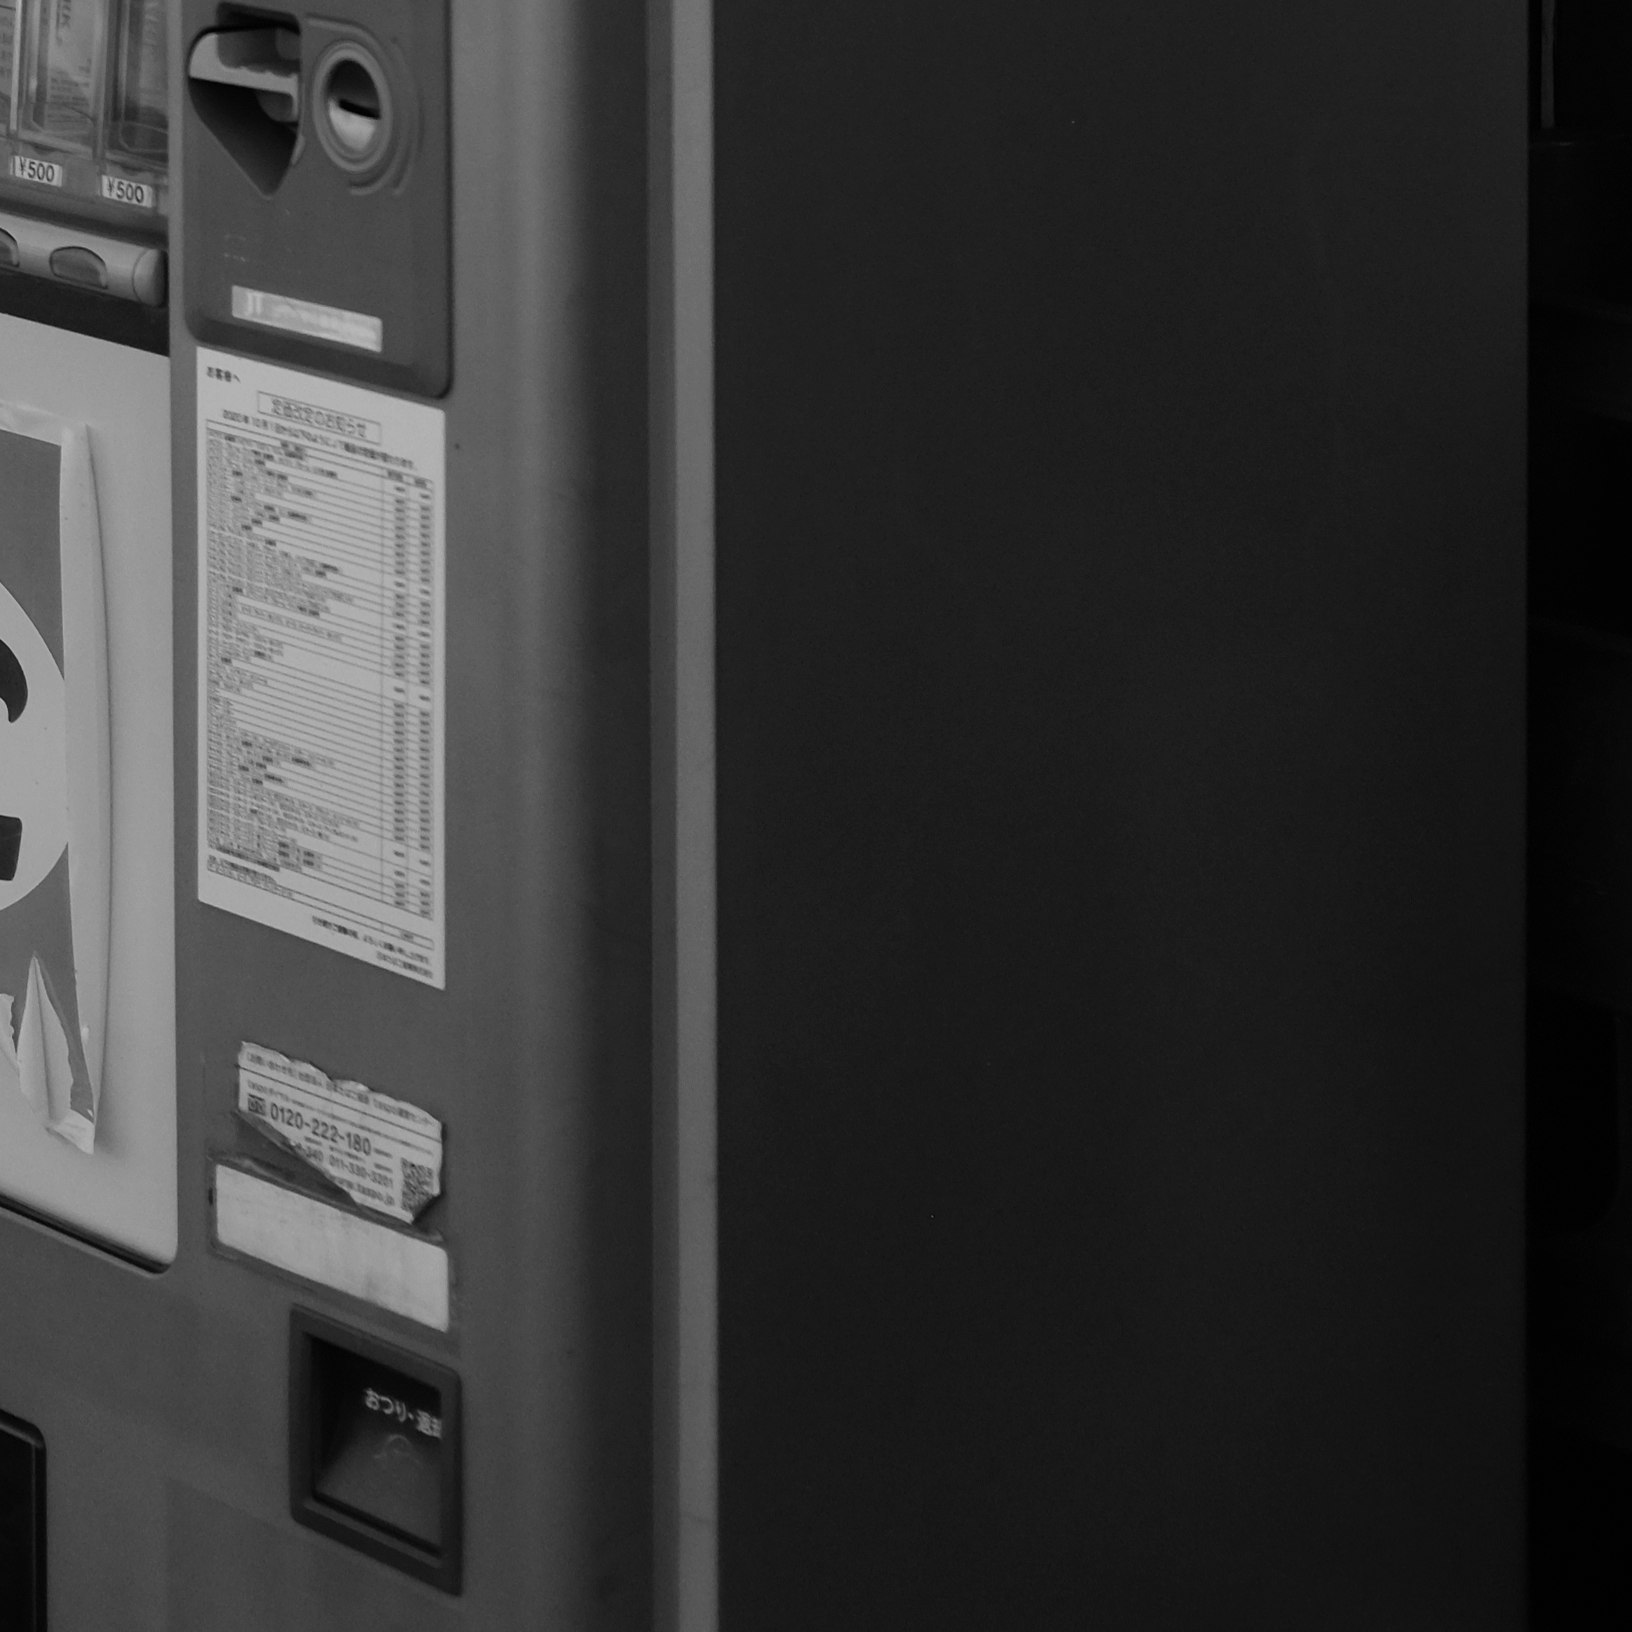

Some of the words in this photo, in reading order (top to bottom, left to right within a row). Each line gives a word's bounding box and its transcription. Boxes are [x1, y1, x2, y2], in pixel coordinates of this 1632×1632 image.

[18, 158, 55, 182] ¥500
[106, 176, 145, 203] ¥500
[270, 1102, 373, 1157] 0120-222-180
